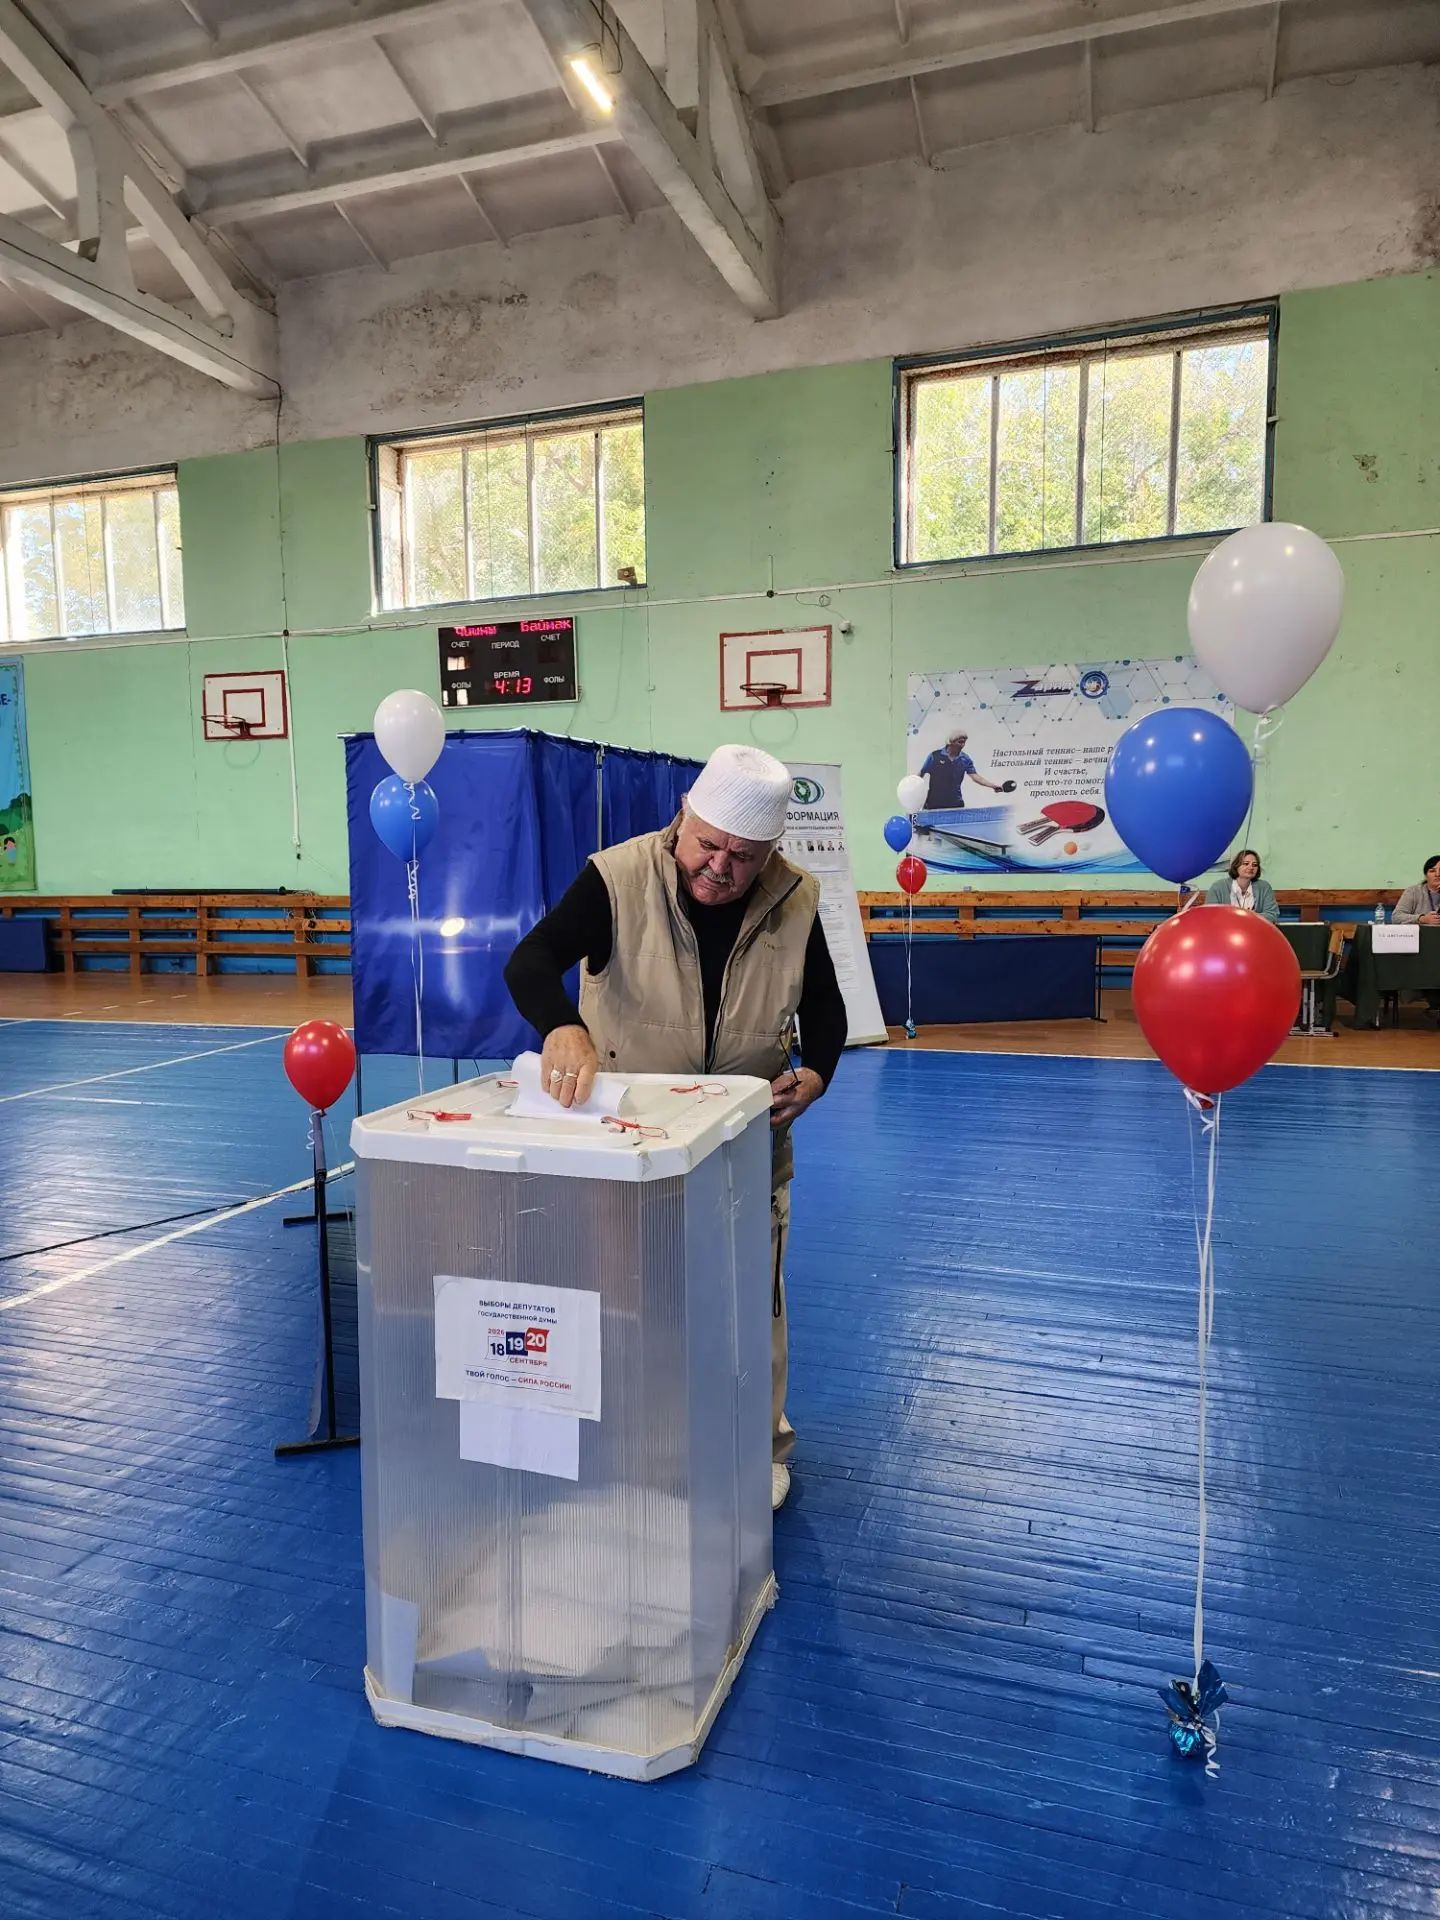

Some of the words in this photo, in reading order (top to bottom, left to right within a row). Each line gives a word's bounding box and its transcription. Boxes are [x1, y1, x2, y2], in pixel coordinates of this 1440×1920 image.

[451, 640, 470, 648] СЧЕТ
[491, 640, 520, 649] ПЕРИОД
[451, 681, 472, 689] ФОЛЫ
[495, 677, 532, 695] 4:13
[0, 693, 12, 705] Е-
[992, 748, 1044, 758] Настольный
[1082, 746, 1106, 754] наше
[990, 758, 1042, 768] Настольный
[1083, 756, 1108, 764] вечна
[1044, 768, 1051, 776] И
[1053, 767, 1088, 776] счастье,
[1023, 779, 1044, 787] если
[1045, 778, 1073, 787] что-то
[1029, 787, 1078, 799] преодолеть
[1080, 786, 1102, 796] себя.
[786, 811, 839, 822] ФОРМАЦИЯ
[479, 1299, 511, 1309] ВЫБОРЫ
[512, 1303, 556, 1313] ДЕПУТАТОВ
[477, 1310, 538, 1321] ГОСУДАРСТВЕННОЙ
[538, 1316, 558, 1324] ДУМЫ
[487, 1328, 505, 1336] 2026
[490, 1342, 505, 1356] 18
[507, 1337, 524, 1351] 19
[526, 1332, 546, 1348] 20
[509, 1357, 548, 1367] СЕНТЯБРЯ
[465, 1369, 485, 1378] ТВОЙ
[486, 1373, 510, 1383] ГОЛОС
[517, 1377, 539, 1385] СИЛА
[540, 1380, 572, 1391] РОССИИ!
